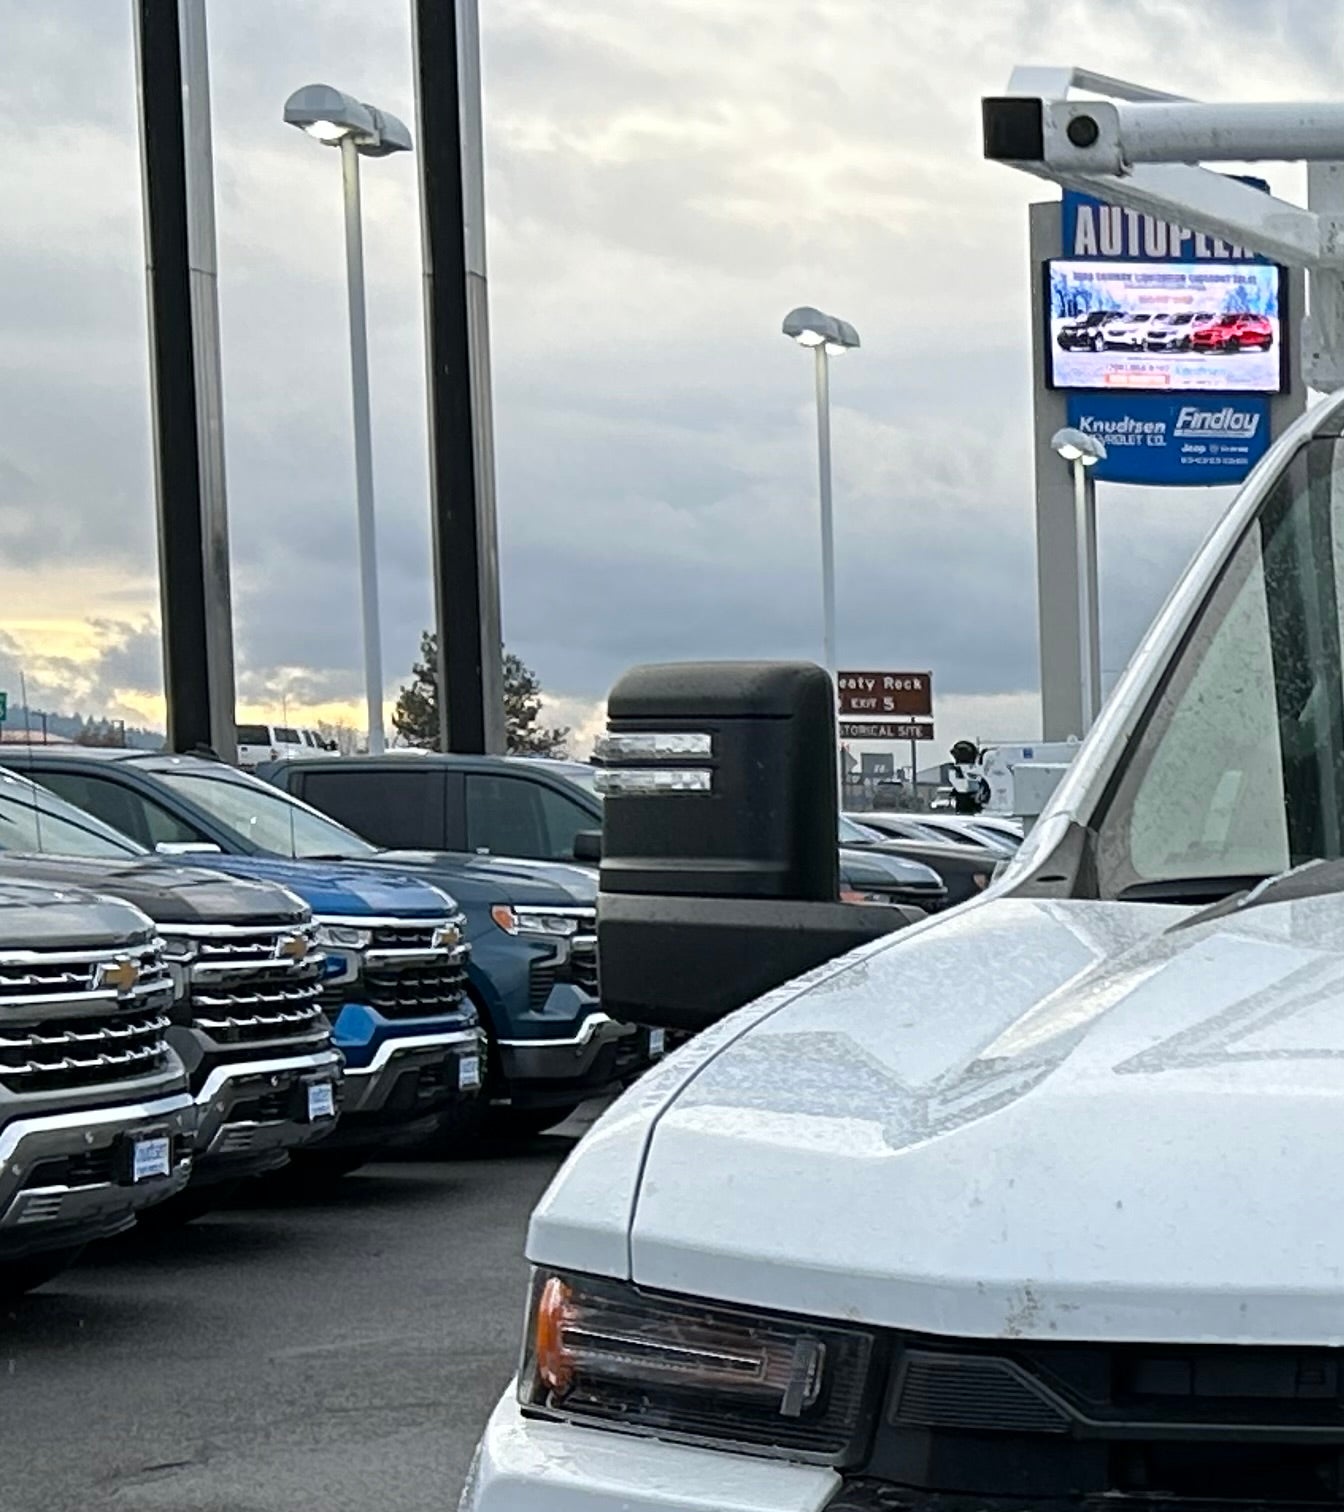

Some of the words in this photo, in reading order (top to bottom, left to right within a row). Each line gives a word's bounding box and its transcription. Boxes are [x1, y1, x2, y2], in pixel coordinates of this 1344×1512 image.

[1074, 205, 1254, 258] AUTOPL
[1079, 415, 1166, 434] Knudtsen
[1176, 406, 1260, 437] Findlay
[839, 677, 875, 692] eaty
[884, 676, 922, 691] Rock
[851, 697, 877, 709] EXIT
[883, 697, 895, 711] 5
[840, 725, 893, 737] TORICAL
[898, 726, 922, 737] SITE
